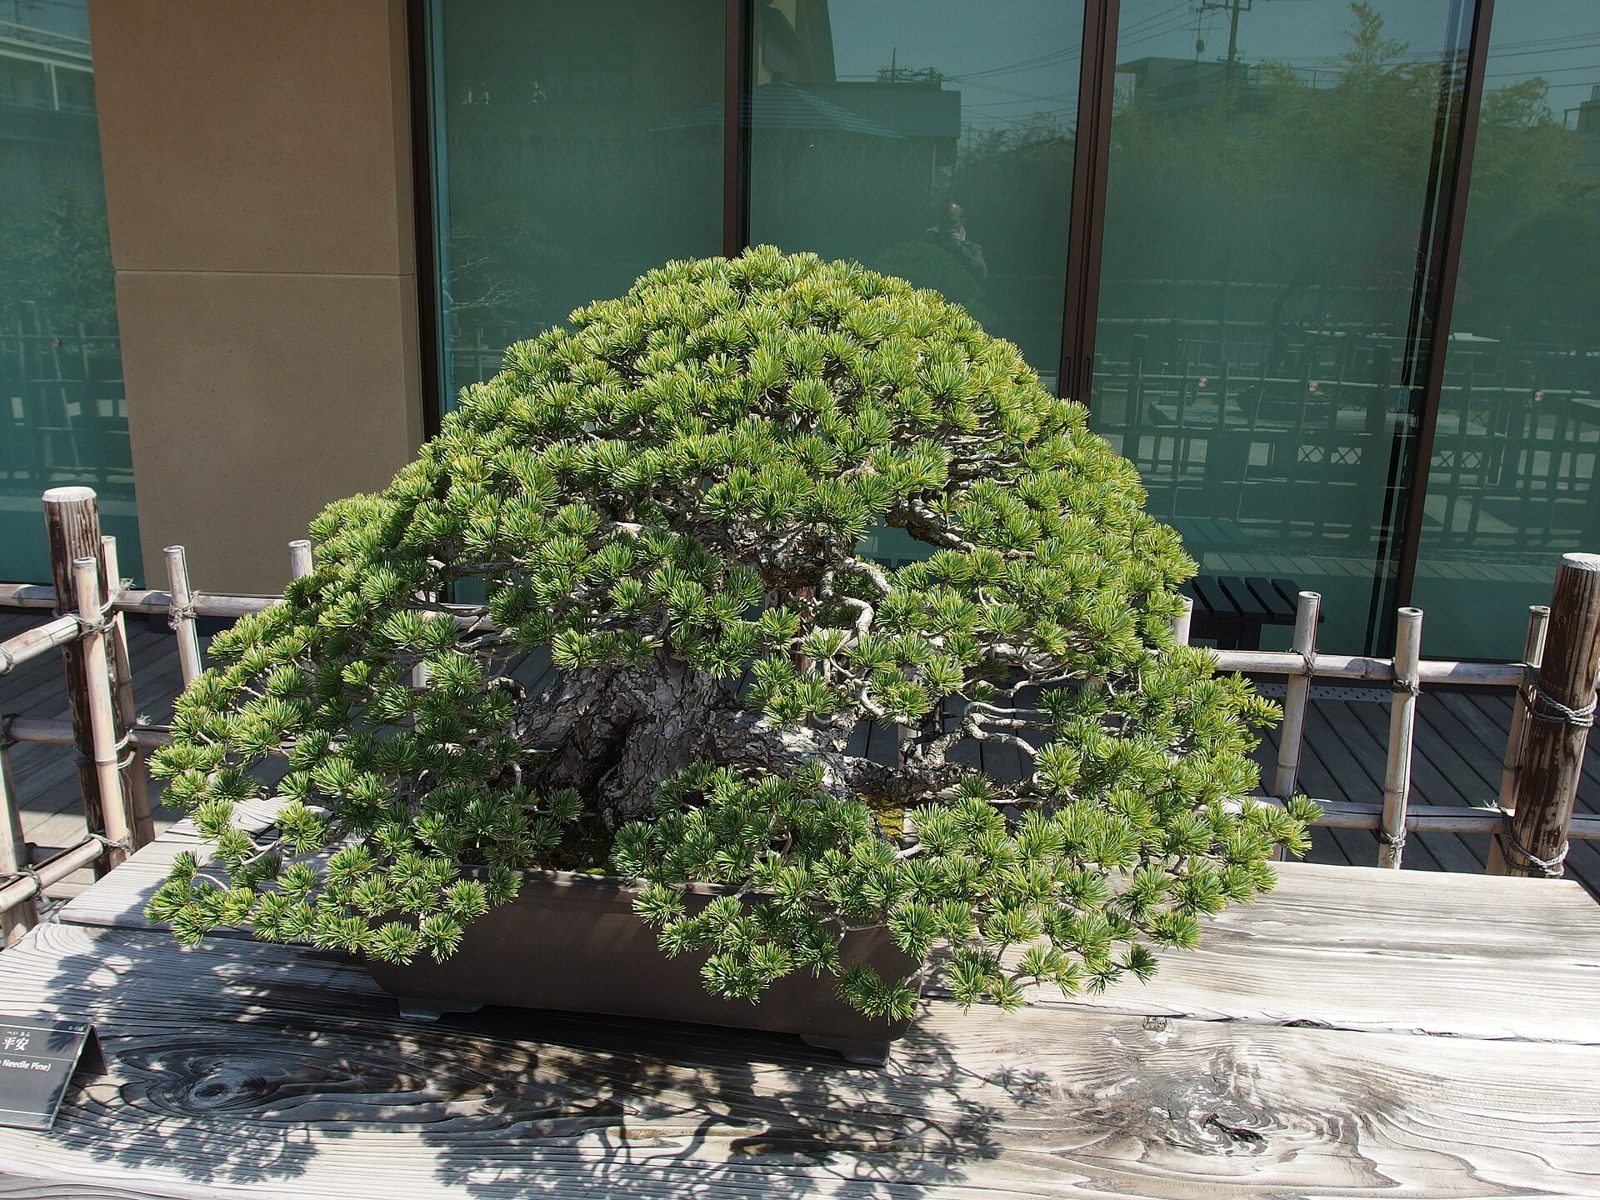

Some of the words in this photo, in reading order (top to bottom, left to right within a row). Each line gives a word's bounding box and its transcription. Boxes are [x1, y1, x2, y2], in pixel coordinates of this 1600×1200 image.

[2, 1036, 30, 1051] 平安
[2, 1059, 30, 1069] Needle
[30, 1062, 52, 1072] Pine)
